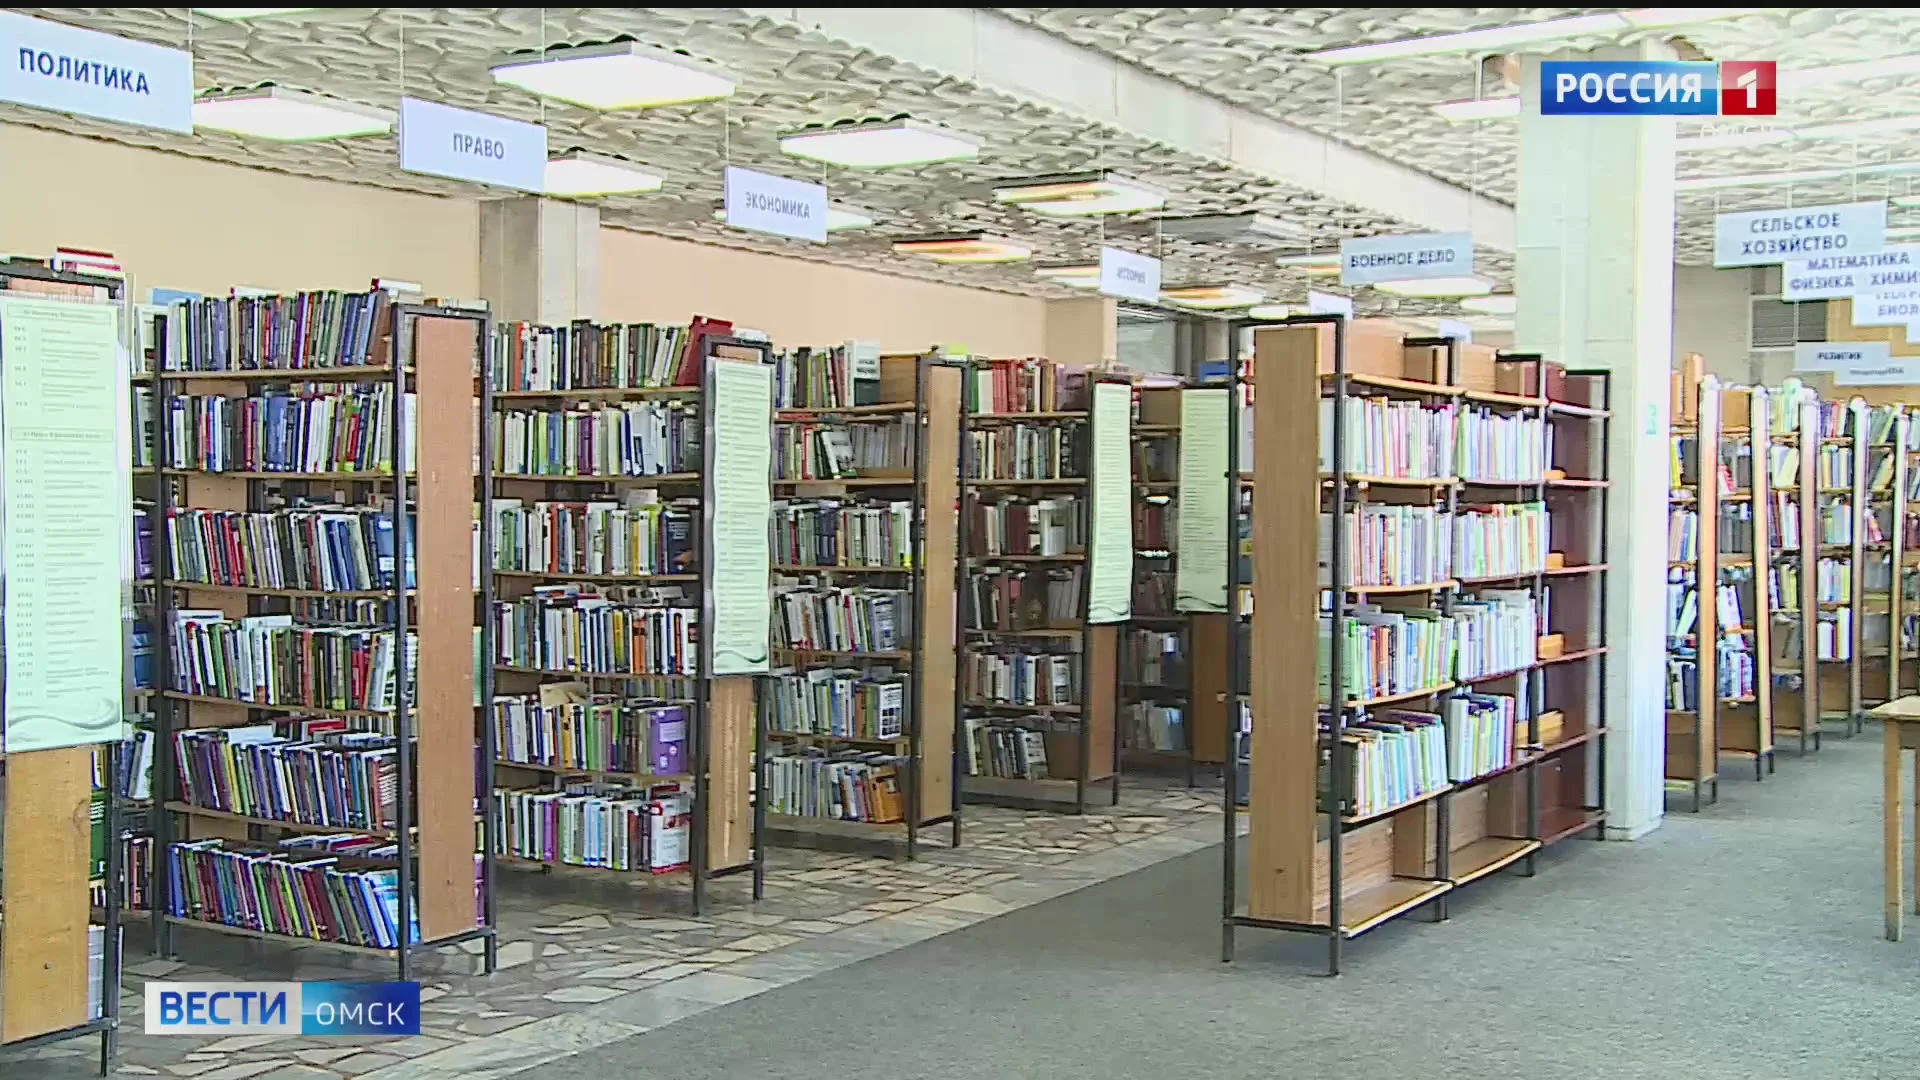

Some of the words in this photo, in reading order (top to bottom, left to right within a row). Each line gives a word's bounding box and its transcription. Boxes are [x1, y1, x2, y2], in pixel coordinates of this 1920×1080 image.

[19, 47, 150, 95] ПОЛИТИКА
[453, 132, 504, 159] ПРАВО
[745, 191, 810, 219] ЭКОНОМИКА
[1750, 213, 1841, 233] СЕЛЬСКОЕ
[1741, 234, 1848, 255] ХОЗЯЙСТВО
[1350, 252, 1414, 267] ВОЕННОЕ
[1417, 248, 1455, 266] ДЕЛО
[1807, 252, 1910, 270] МАТЕМАТИКА
[1790, 275, 1855, 290] ФИЗИКА
[1870, 270, 1920, 286] ХИМИ
